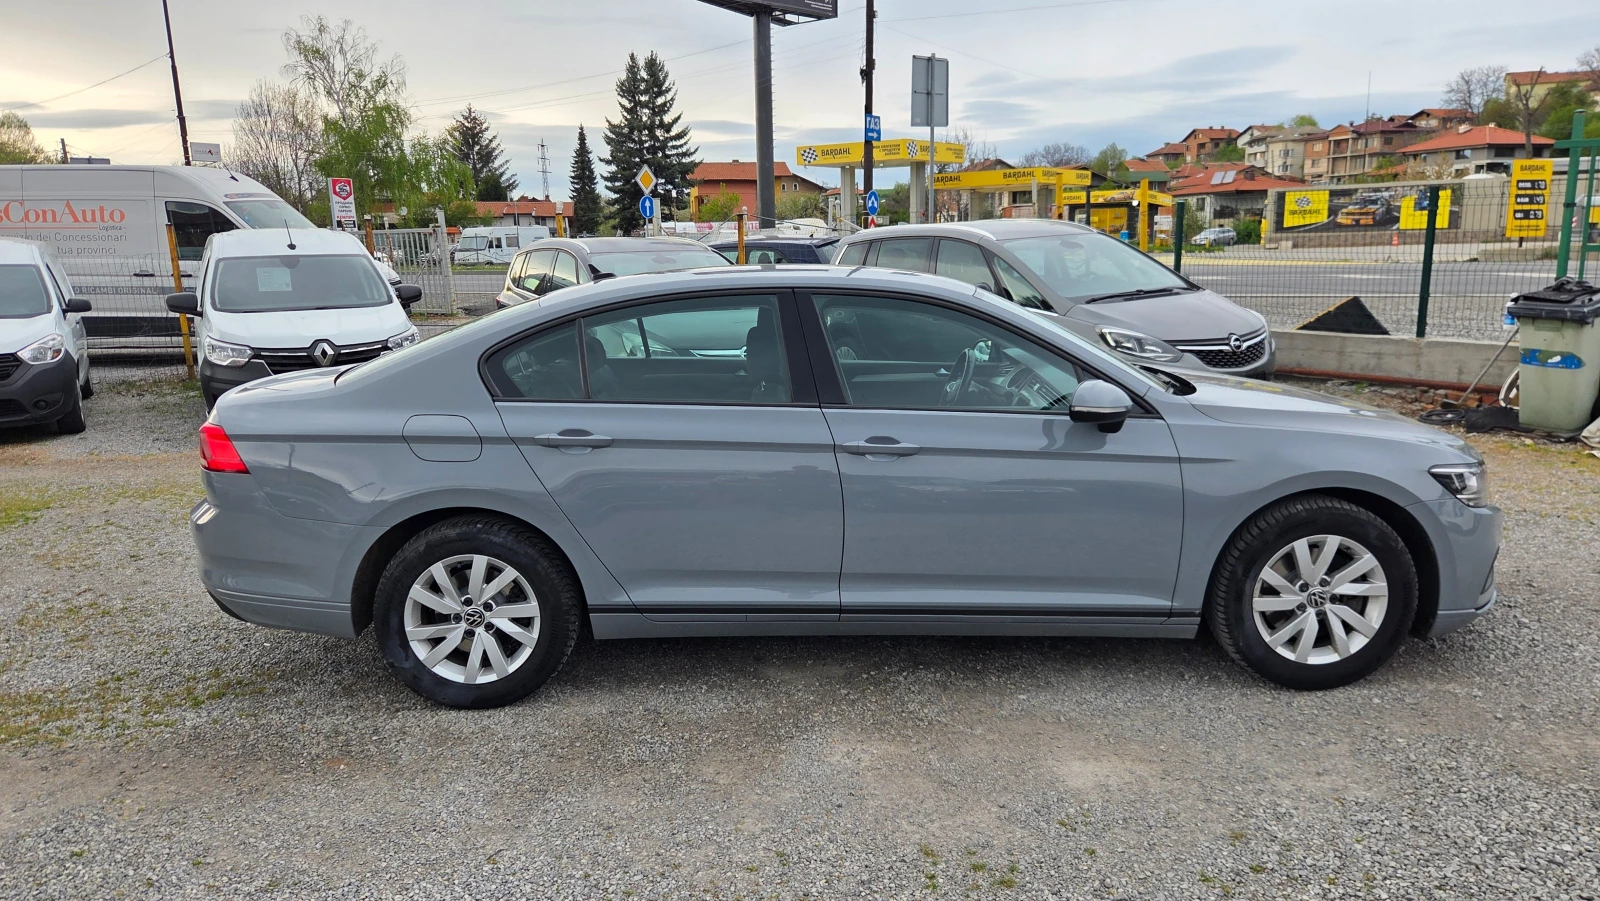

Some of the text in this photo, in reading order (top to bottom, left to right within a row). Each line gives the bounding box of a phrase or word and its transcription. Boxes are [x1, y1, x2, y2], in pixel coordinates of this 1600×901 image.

[866, 116, 880, 130] ГАЗ
[821, 147, 852, 159] BARDAHL
[1520, 164, 1547, 174] BARDAHL
[1003, 170, 1036, 181] BARDAHL
[1042, 169, 1057, 180] BARDAH
[1063, 195, 1082, 203] ARDAHL
[1289, 209, 1322, 219] BARDAHL
[36, 232, 51, 241] dei
[54, 232, 127, 242] Concessionari
[57, 245, 116, 255] tua provinci
[82, 286, 116, 294] RICAMBI
